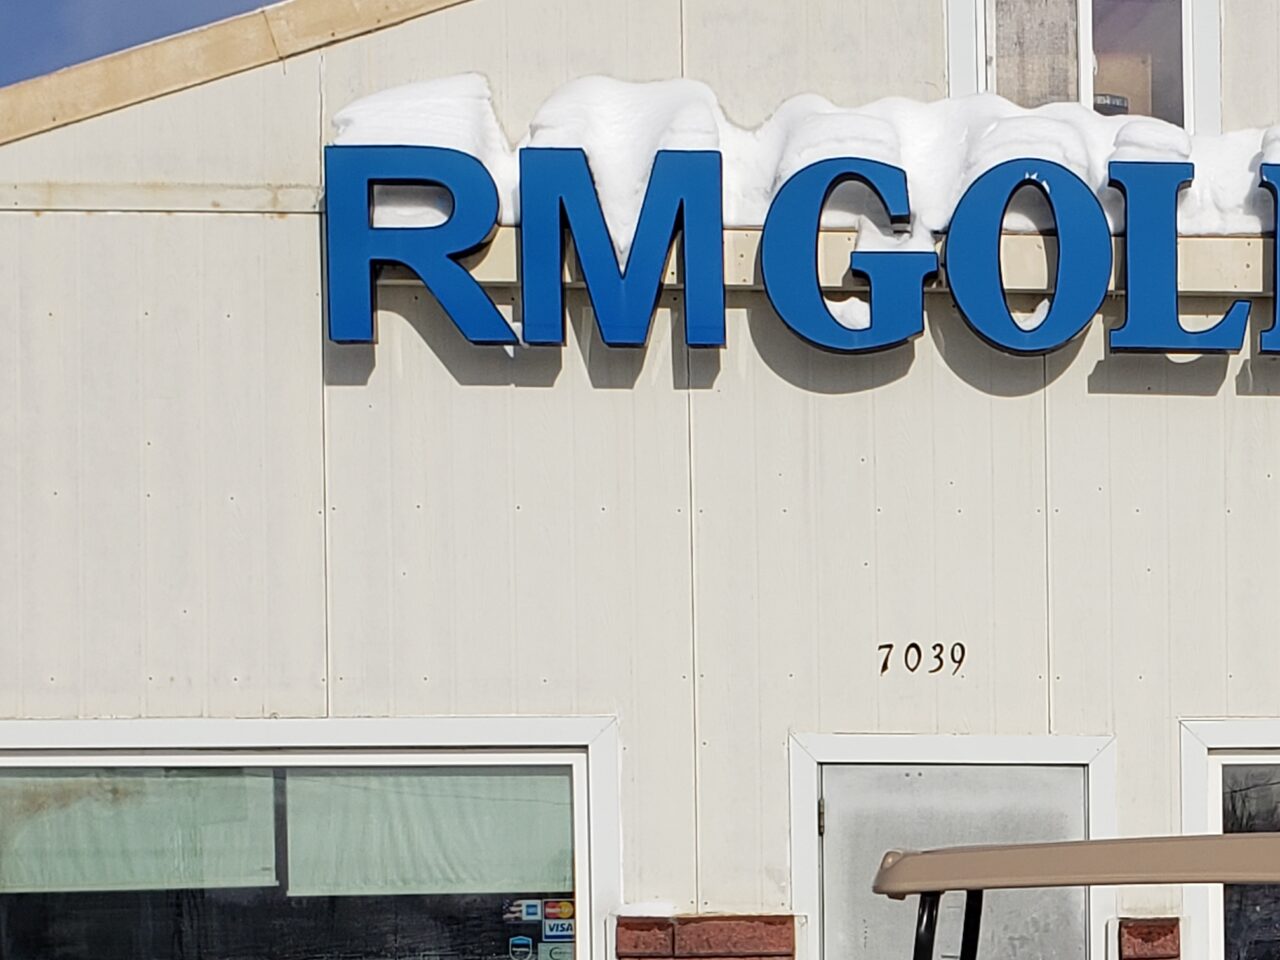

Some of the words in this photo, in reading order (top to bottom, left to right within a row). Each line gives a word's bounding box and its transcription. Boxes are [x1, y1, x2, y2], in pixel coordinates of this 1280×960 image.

[325, 144, 726, 348] RM
[878, 642, 966, 676] 7039
[549, 923, 573, 932] VISA
